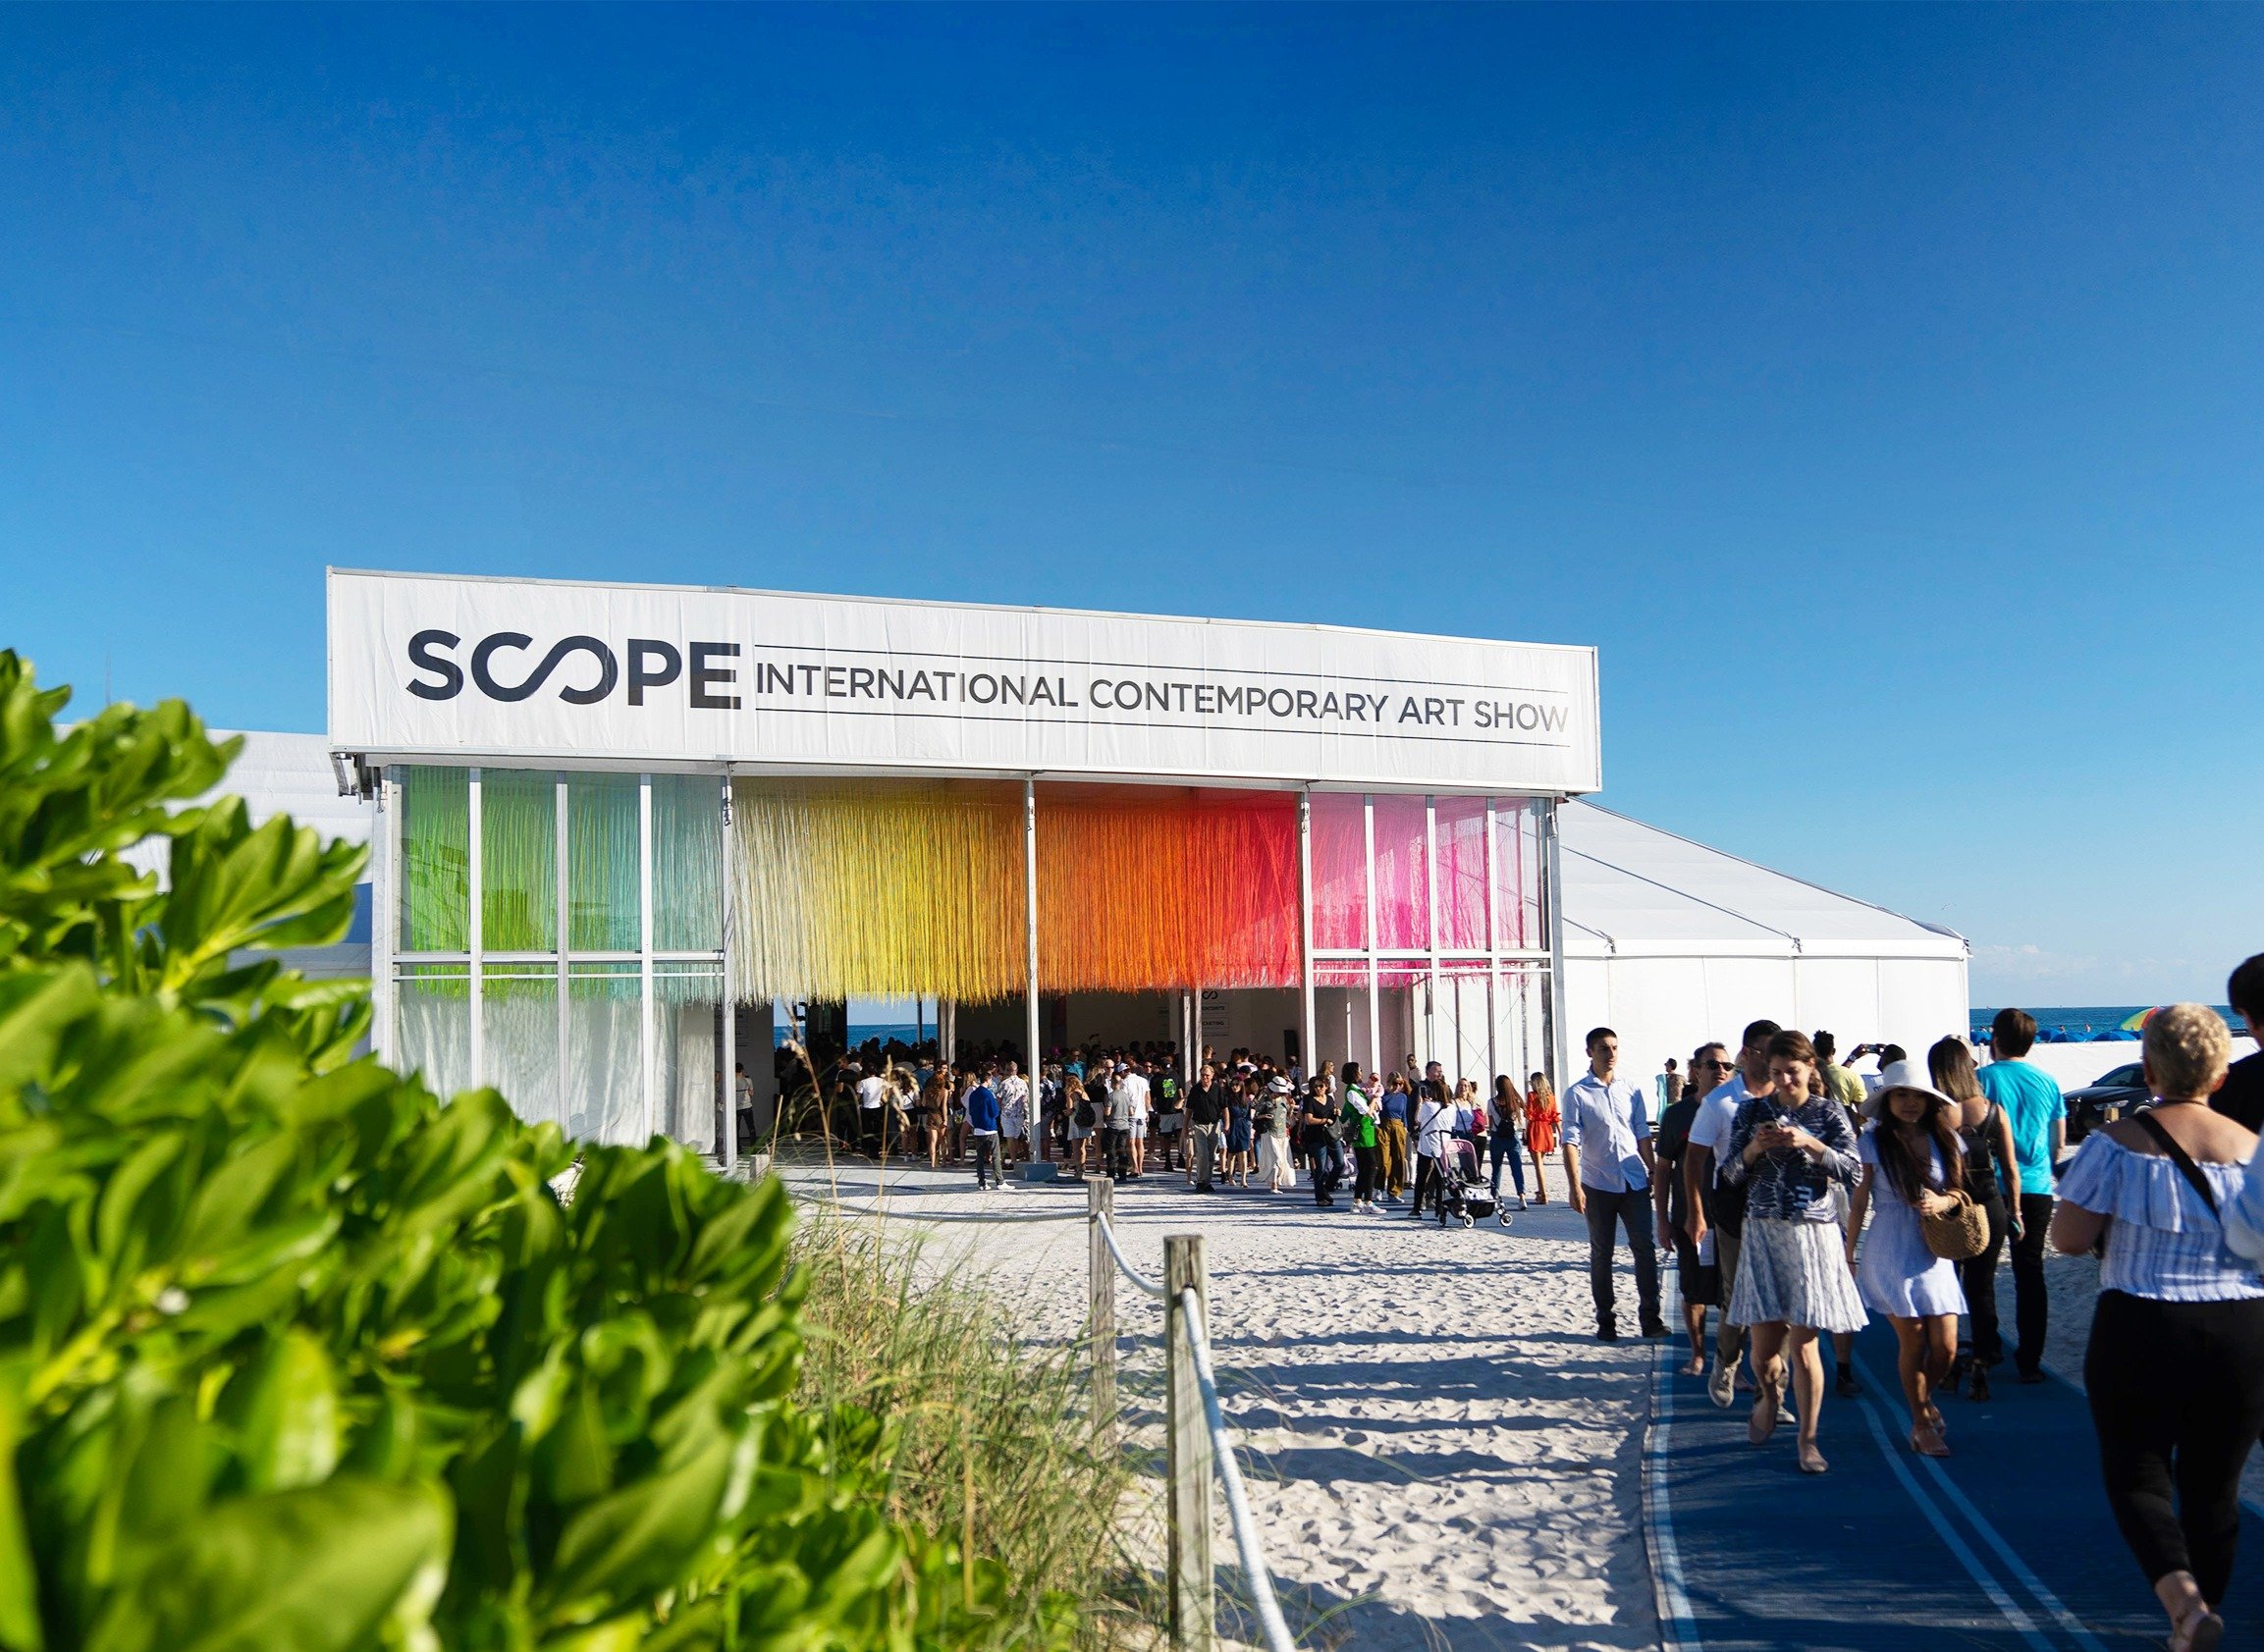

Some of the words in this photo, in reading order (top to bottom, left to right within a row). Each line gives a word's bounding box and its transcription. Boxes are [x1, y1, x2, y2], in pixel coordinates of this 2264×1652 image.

[405, 629, 740, 709] SCOPE
[757, 663, 1078, 707] INTERNATIONAL
[1091, 678, 1388, 721] CONTEMPORARY
[1399, 696, 1464, 725] ART
[1474, 701, 1569, 732] SHOW
